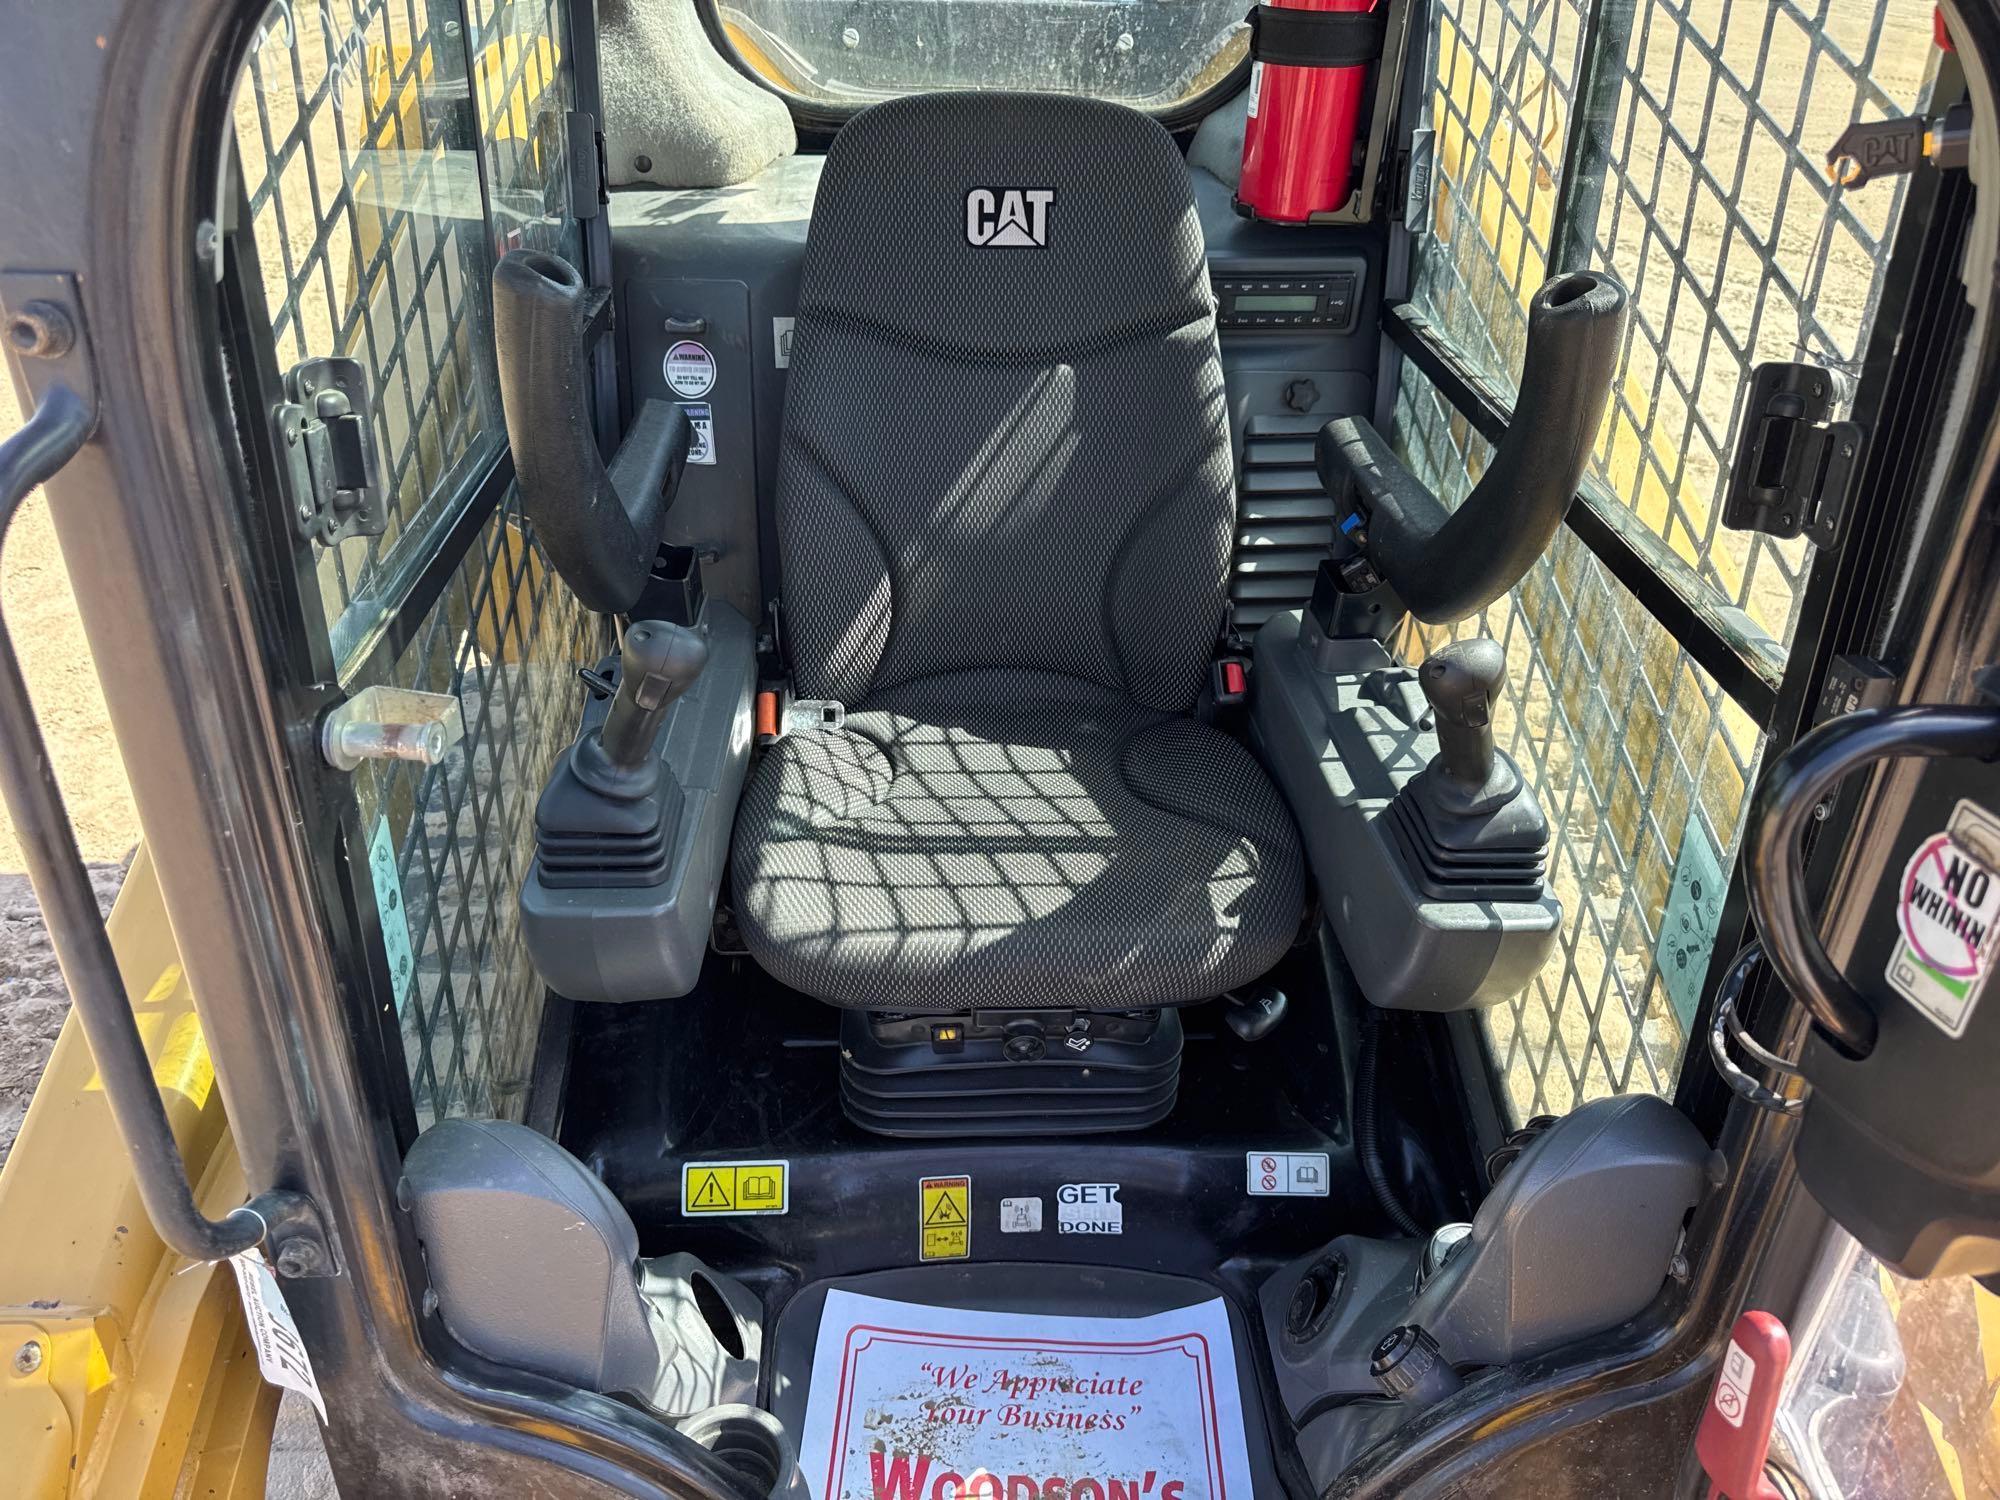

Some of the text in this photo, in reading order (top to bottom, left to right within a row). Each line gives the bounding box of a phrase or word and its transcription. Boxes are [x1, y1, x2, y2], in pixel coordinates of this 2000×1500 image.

[1864, 132, 1914, 167] CAT
[967, 189, 1054, 246] CAT
[1942, 854, 1991, 909] NO
[1059, 1186, 1118, 1204] GET
[1060, 1221, 1121, 1233] DONE
[982, 1368, 1144, 1400] Appreciate
[919, 1401, 993, 1425] Your
